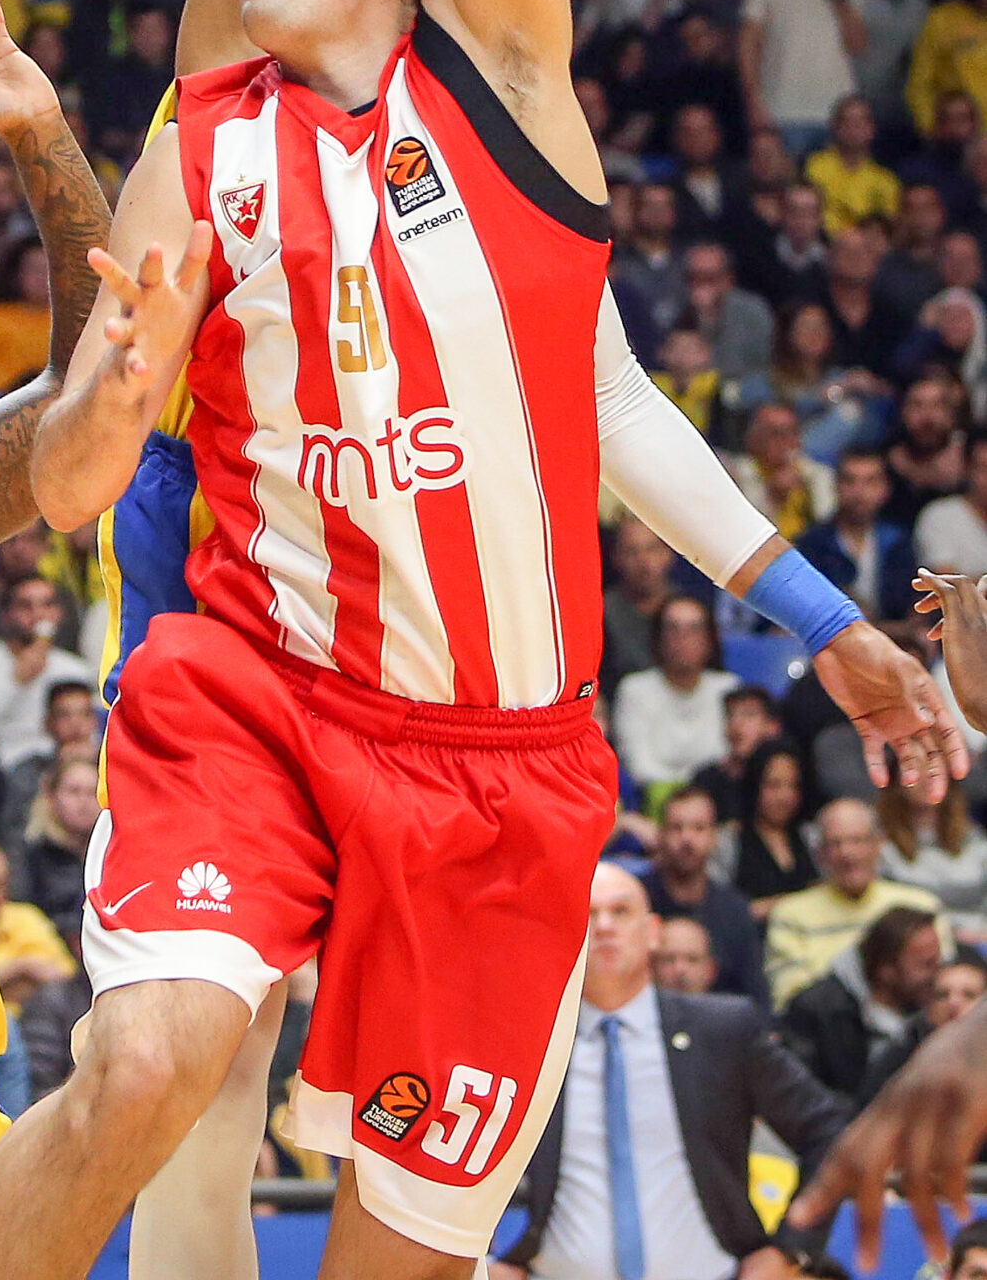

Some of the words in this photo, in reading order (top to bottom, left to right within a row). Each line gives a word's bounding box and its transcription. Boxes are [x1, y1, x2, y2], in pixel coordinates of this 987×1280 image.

[394, 173, 435, 196] TURKISH
[398, 181, 439, 205] AIRLINES
[337, 265, 387, 373] 51
[298, 416, 464, 499] mts
[175, 899, 232, 914] HUAWEI
[365, 1109, 403, 1135] AIRLINES
[369, 1103, 408, 1129] TURKISH
[420, 1064, 518, 1176] 51
